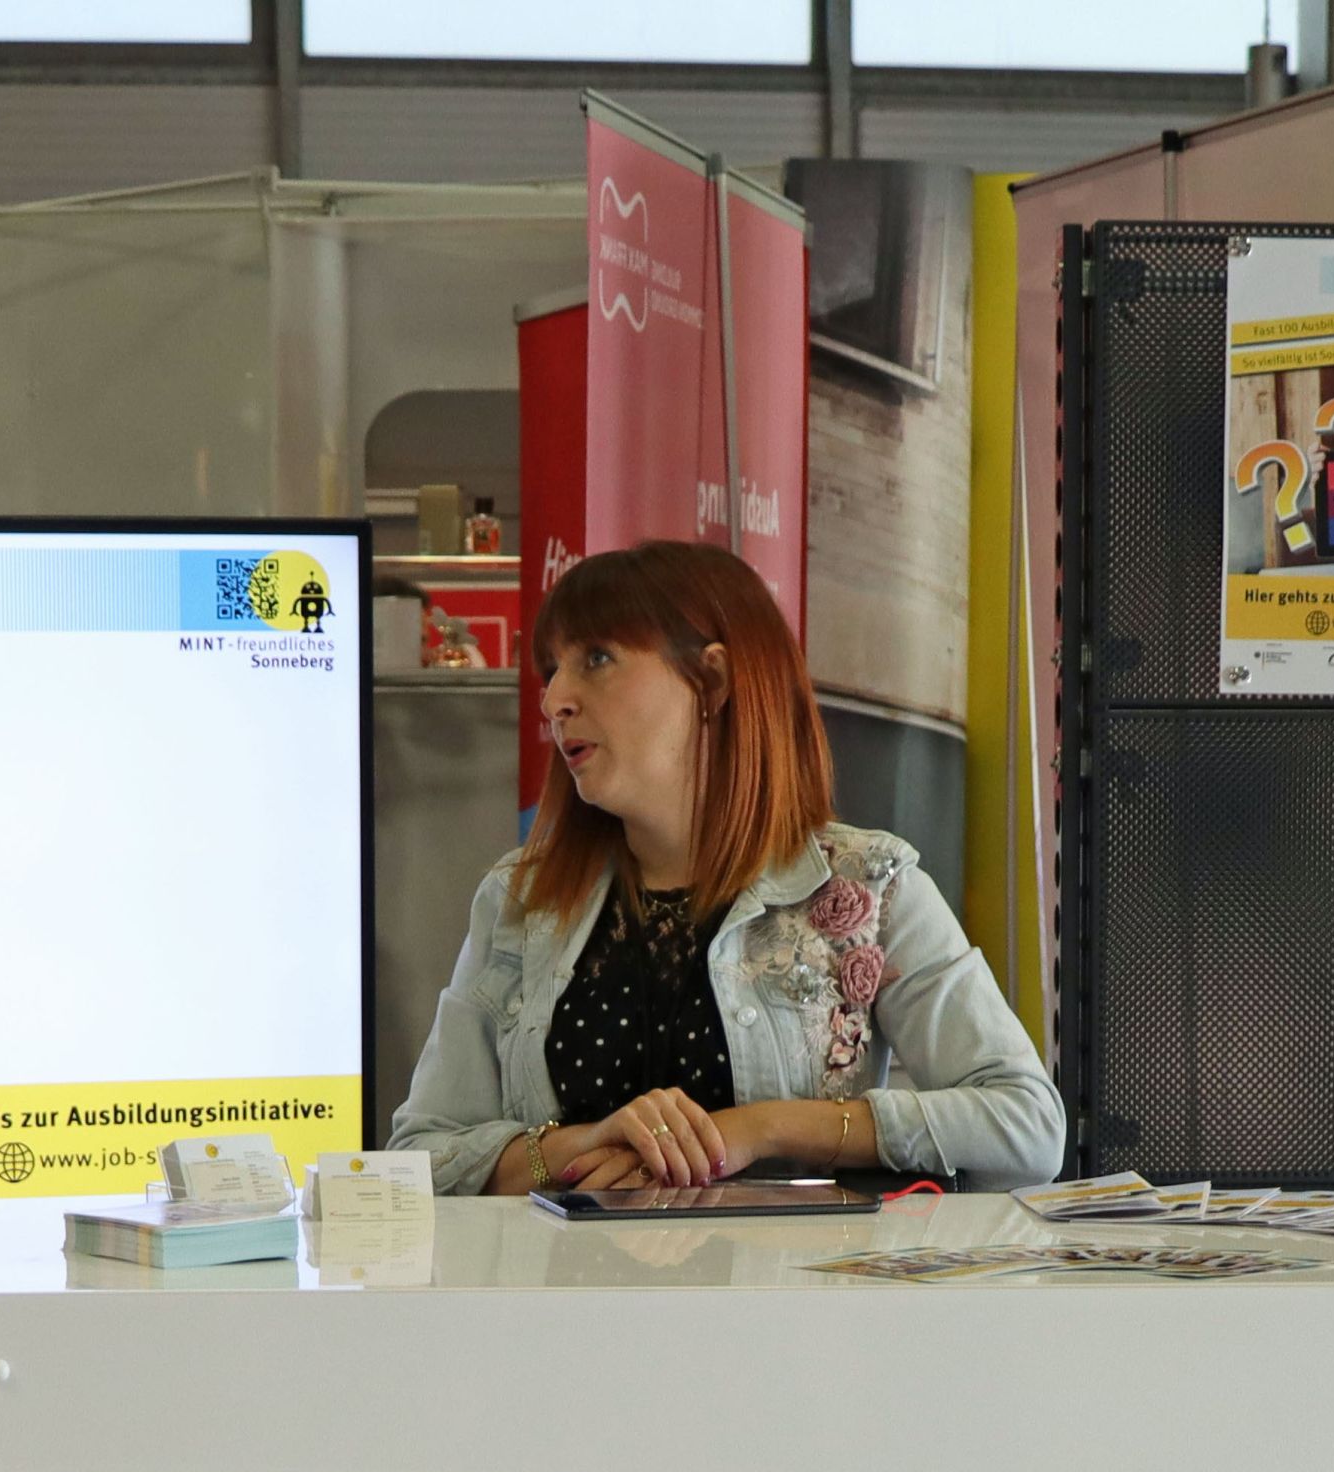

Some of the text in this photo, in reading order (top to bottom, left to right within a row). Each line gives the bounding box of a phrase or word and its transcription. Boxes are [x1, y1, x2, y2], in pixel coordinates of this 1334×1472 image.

[1253, 325, 1274, 336] Fast
[1278, 323, 1299, 334] 100
[1242, 357, 1256, 368] So
[1258, 353, 1302, 367] vielfältig
[1304, 350, 1317, 362] ist
[1245, 589, 1273, 602] Hier
[1278, 589, 1318, 606] gehts
[179, 637, 335, 651] MINT-freundliches
[251, 654, 334, 671] Sonneberg
[21, 1111, 58, 1129] zur
[67, 1099, 334, 1129] Ausbildungsinitiative:
